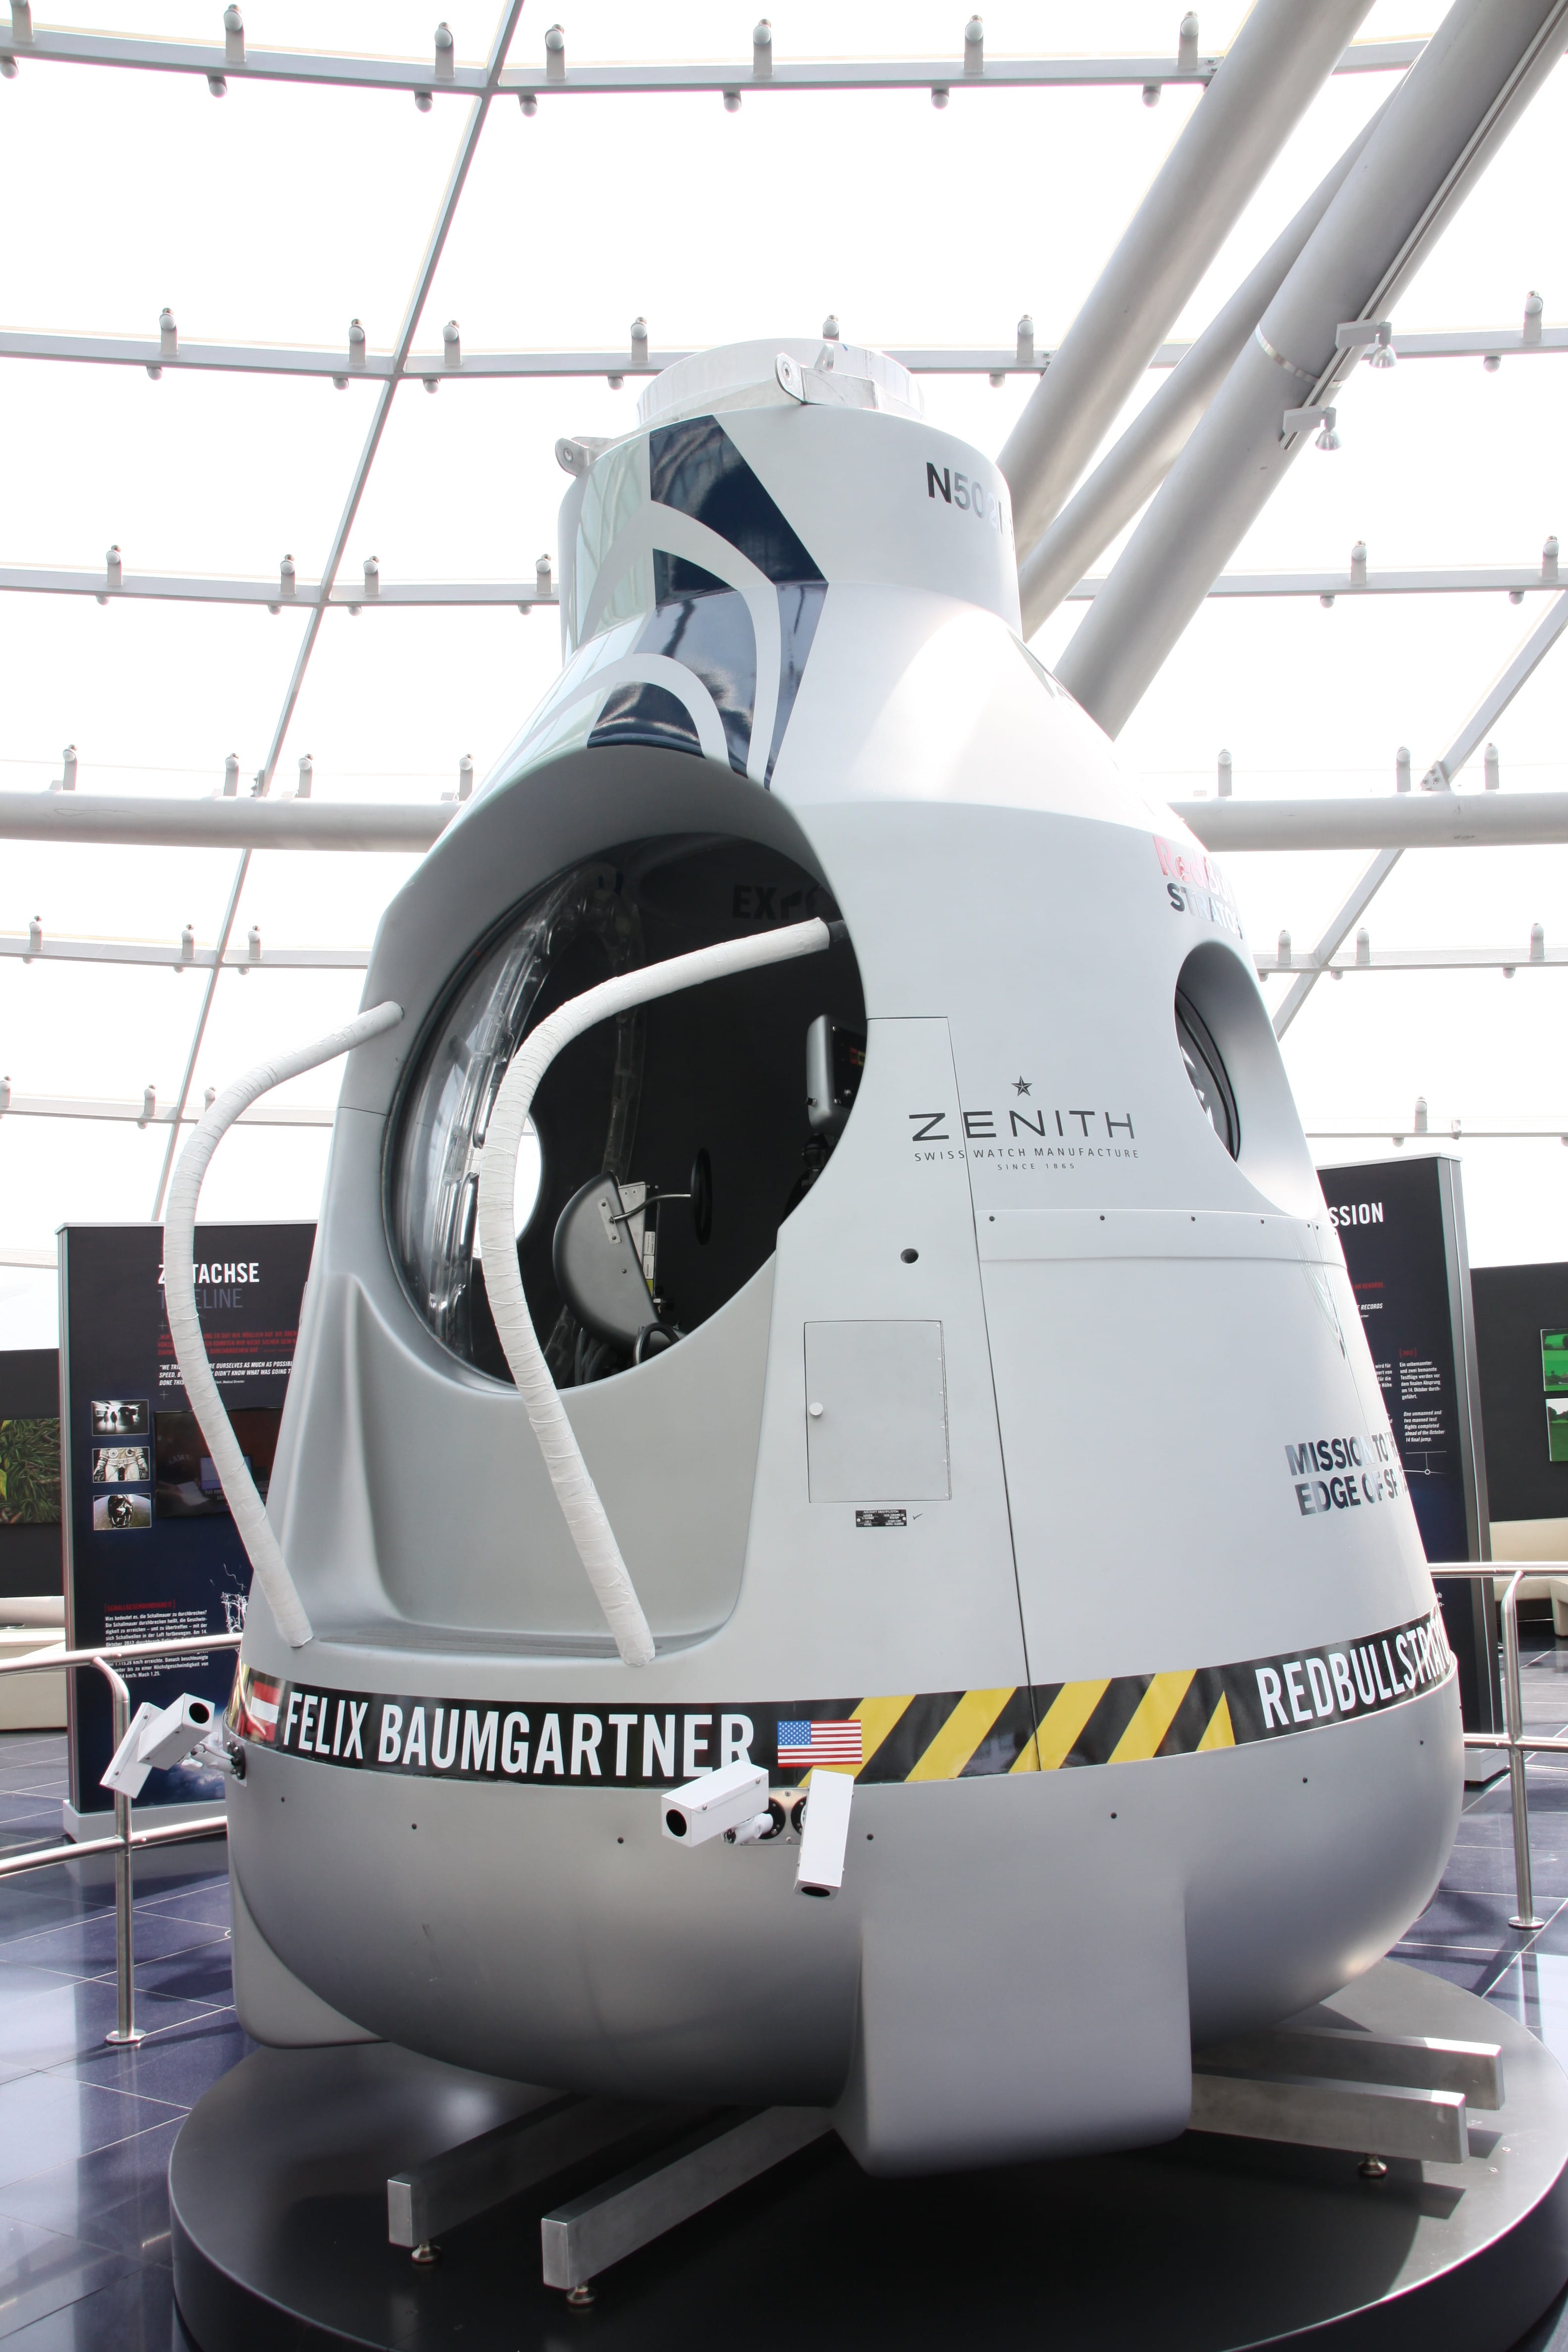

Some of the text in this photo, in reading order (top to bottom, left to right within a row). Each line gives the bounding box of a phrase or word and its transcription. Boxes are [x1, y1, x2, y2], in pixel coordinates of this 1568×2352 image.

[909, 1110, 1135, 1141] ZENITH
[915, 1147, 1139, 1162] SWISS WATCH MANUFACTURE
[1328, 1202, 1383, 1227] SSION
[158, 1263, 260, 1284] ZTACHSE
[1284, 1435, 1375, 1476] MISSION
[1371, 1432, 1389, 1463] TO
[1294, 1475, 1361, 1516] EDGE
[1362, 1471, 1383, 1504] OF
[283, 1691, 754, 1777] FELIX BAUMGARTNER
